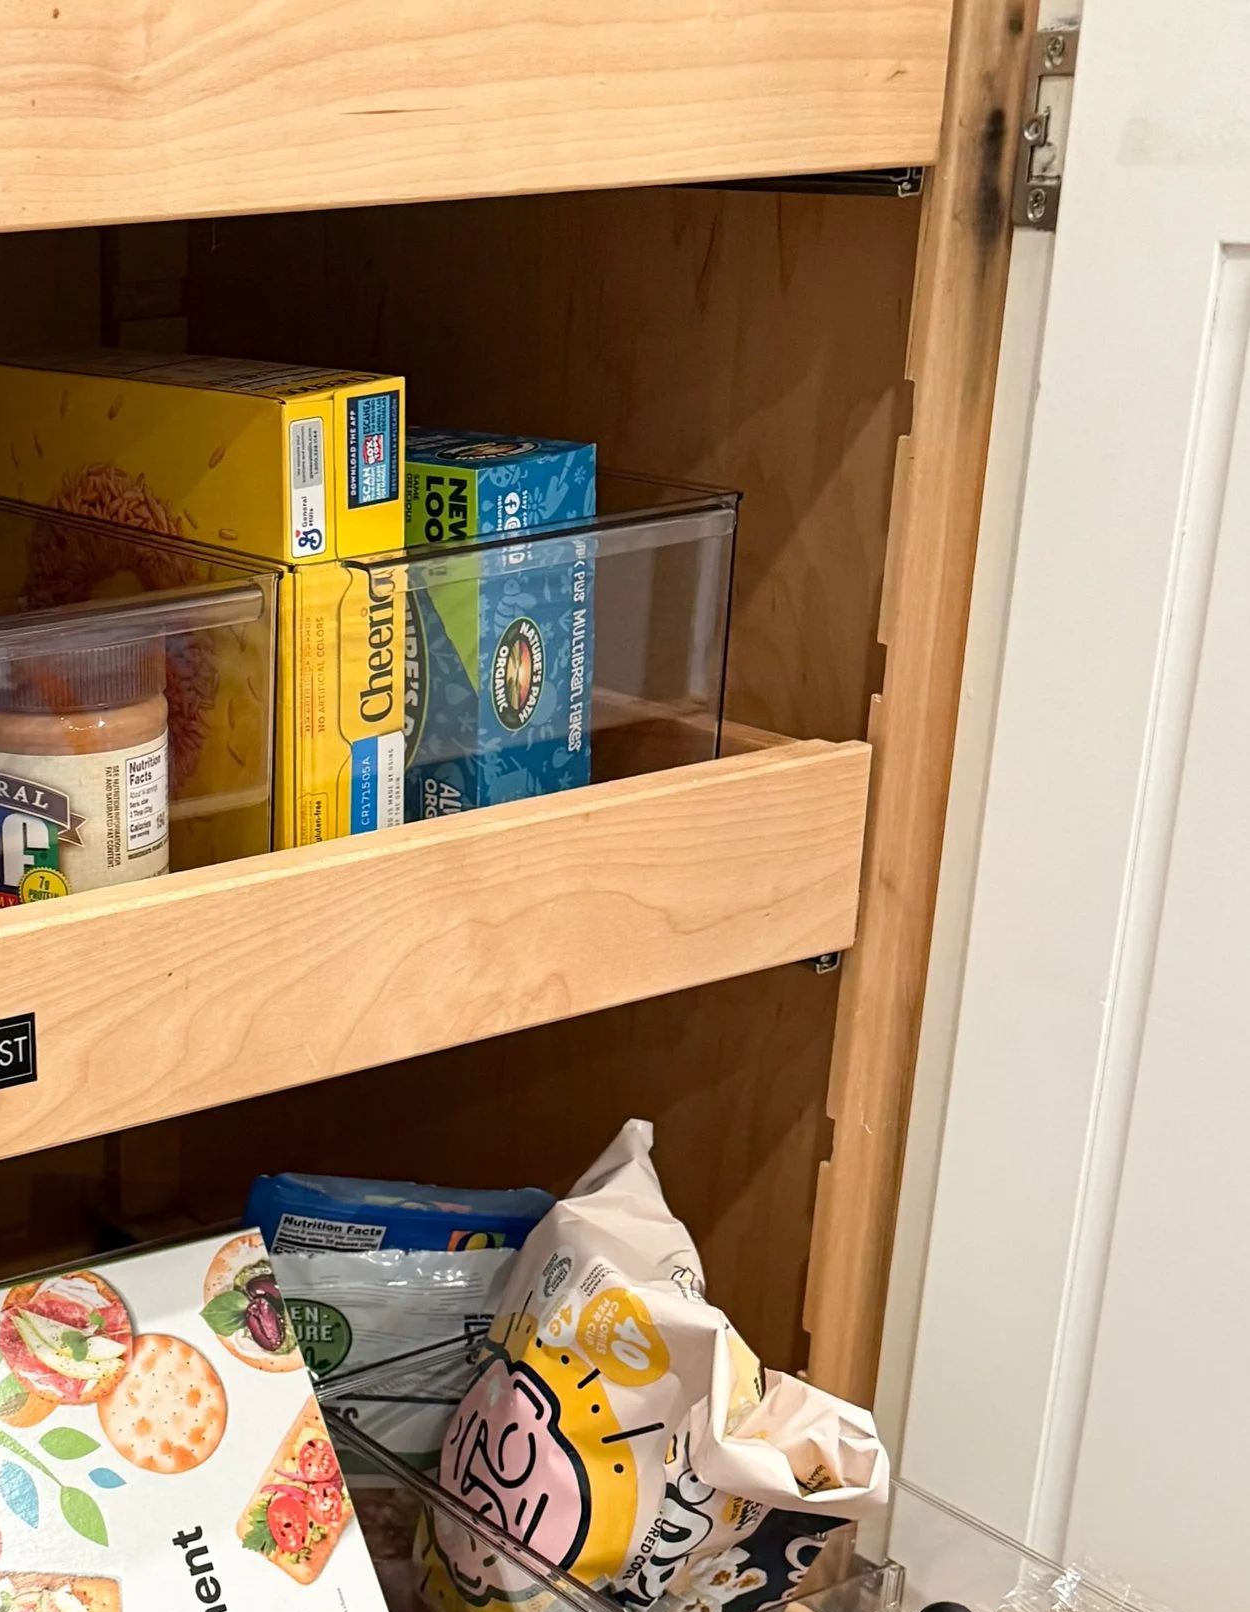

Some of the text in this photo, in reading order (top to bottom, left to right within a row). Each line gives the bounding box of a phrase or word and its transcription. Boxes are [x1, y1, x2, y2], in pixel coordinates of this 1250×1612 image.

[448, 478, 468, 541] NEW
[495, 646, 509, 713] ORGANIC
[519, 622, 542, 723] NATURE'S PATH
[130, 755, 161, 773] Nutrition
[130, 771, 152, 785] Facts
[283, 1217, 382, 1236] Nutrition Facts
[593, 1298, 610, 1321] PER
[596, 1302, 619, 1354] CALORIES
[611, 1316, 651, 1370] 40
